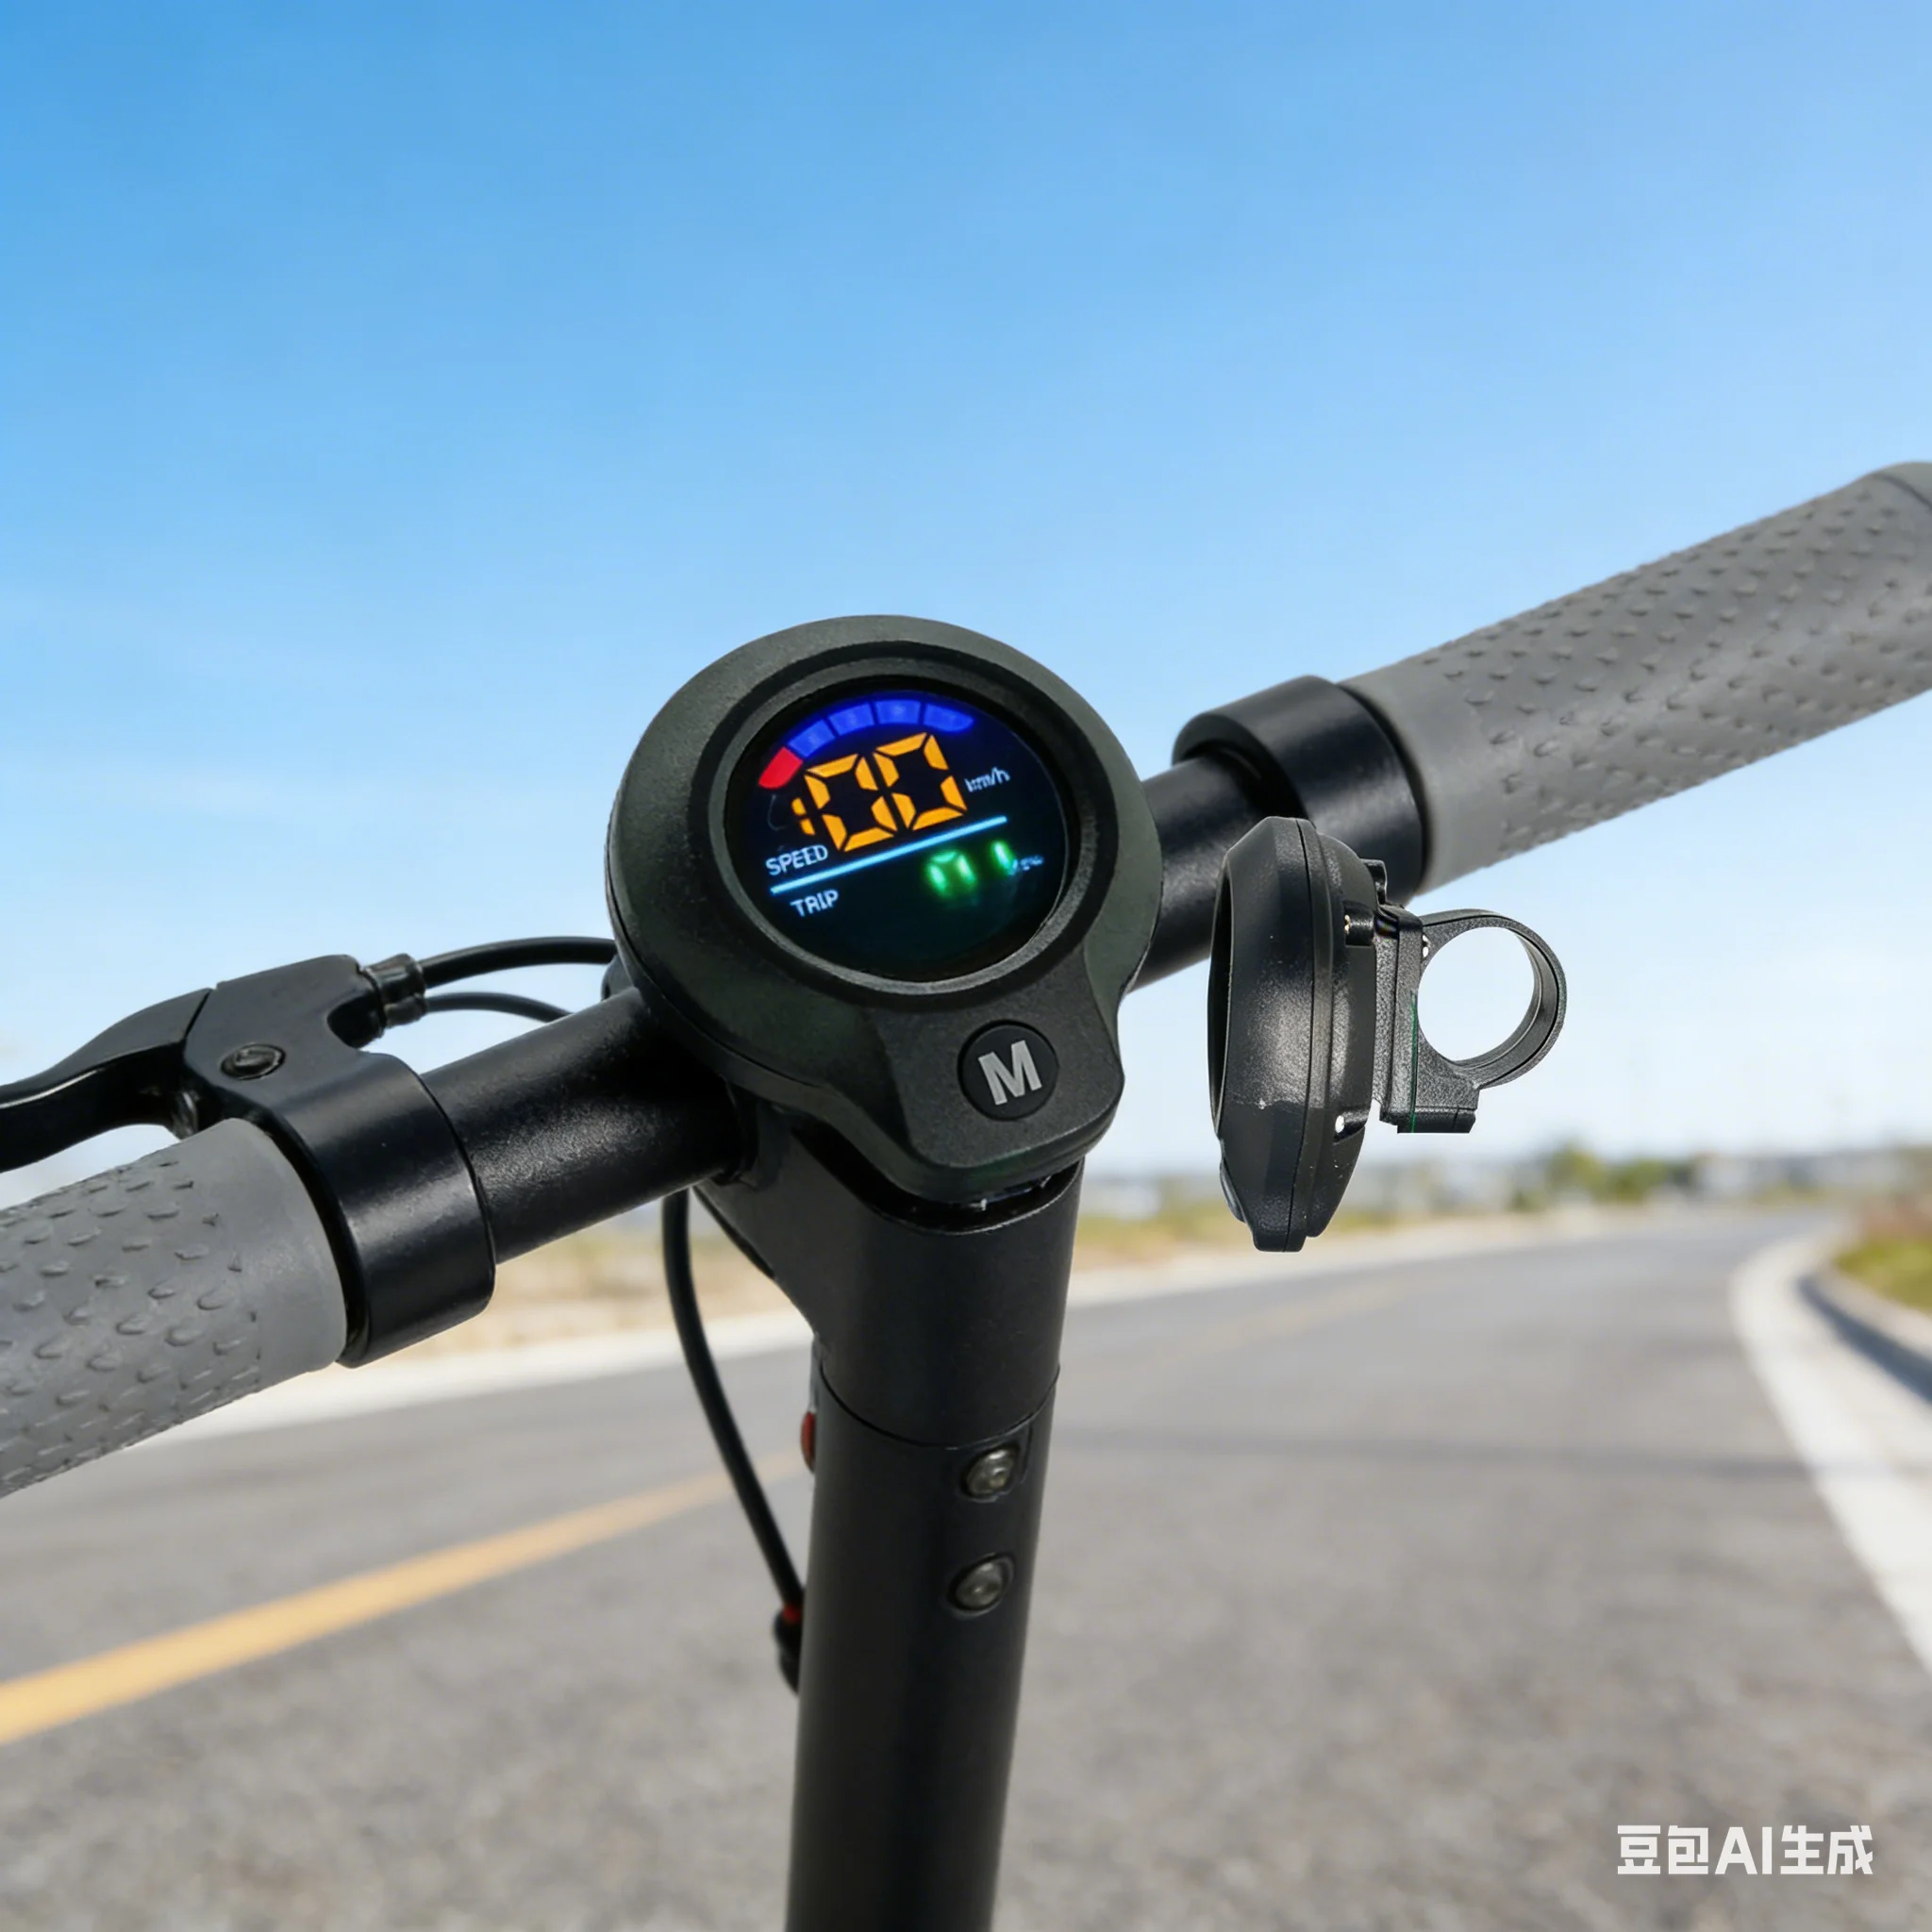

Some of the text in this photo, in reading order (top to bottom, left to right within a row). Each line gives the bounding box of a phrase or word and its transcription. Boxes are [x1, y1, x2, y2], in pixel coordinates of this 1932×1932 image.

[765, 844, 828, 875] SPEED
[790, 890, 839, 917] TRIP
[977, 1040, 1042, 1106] M
